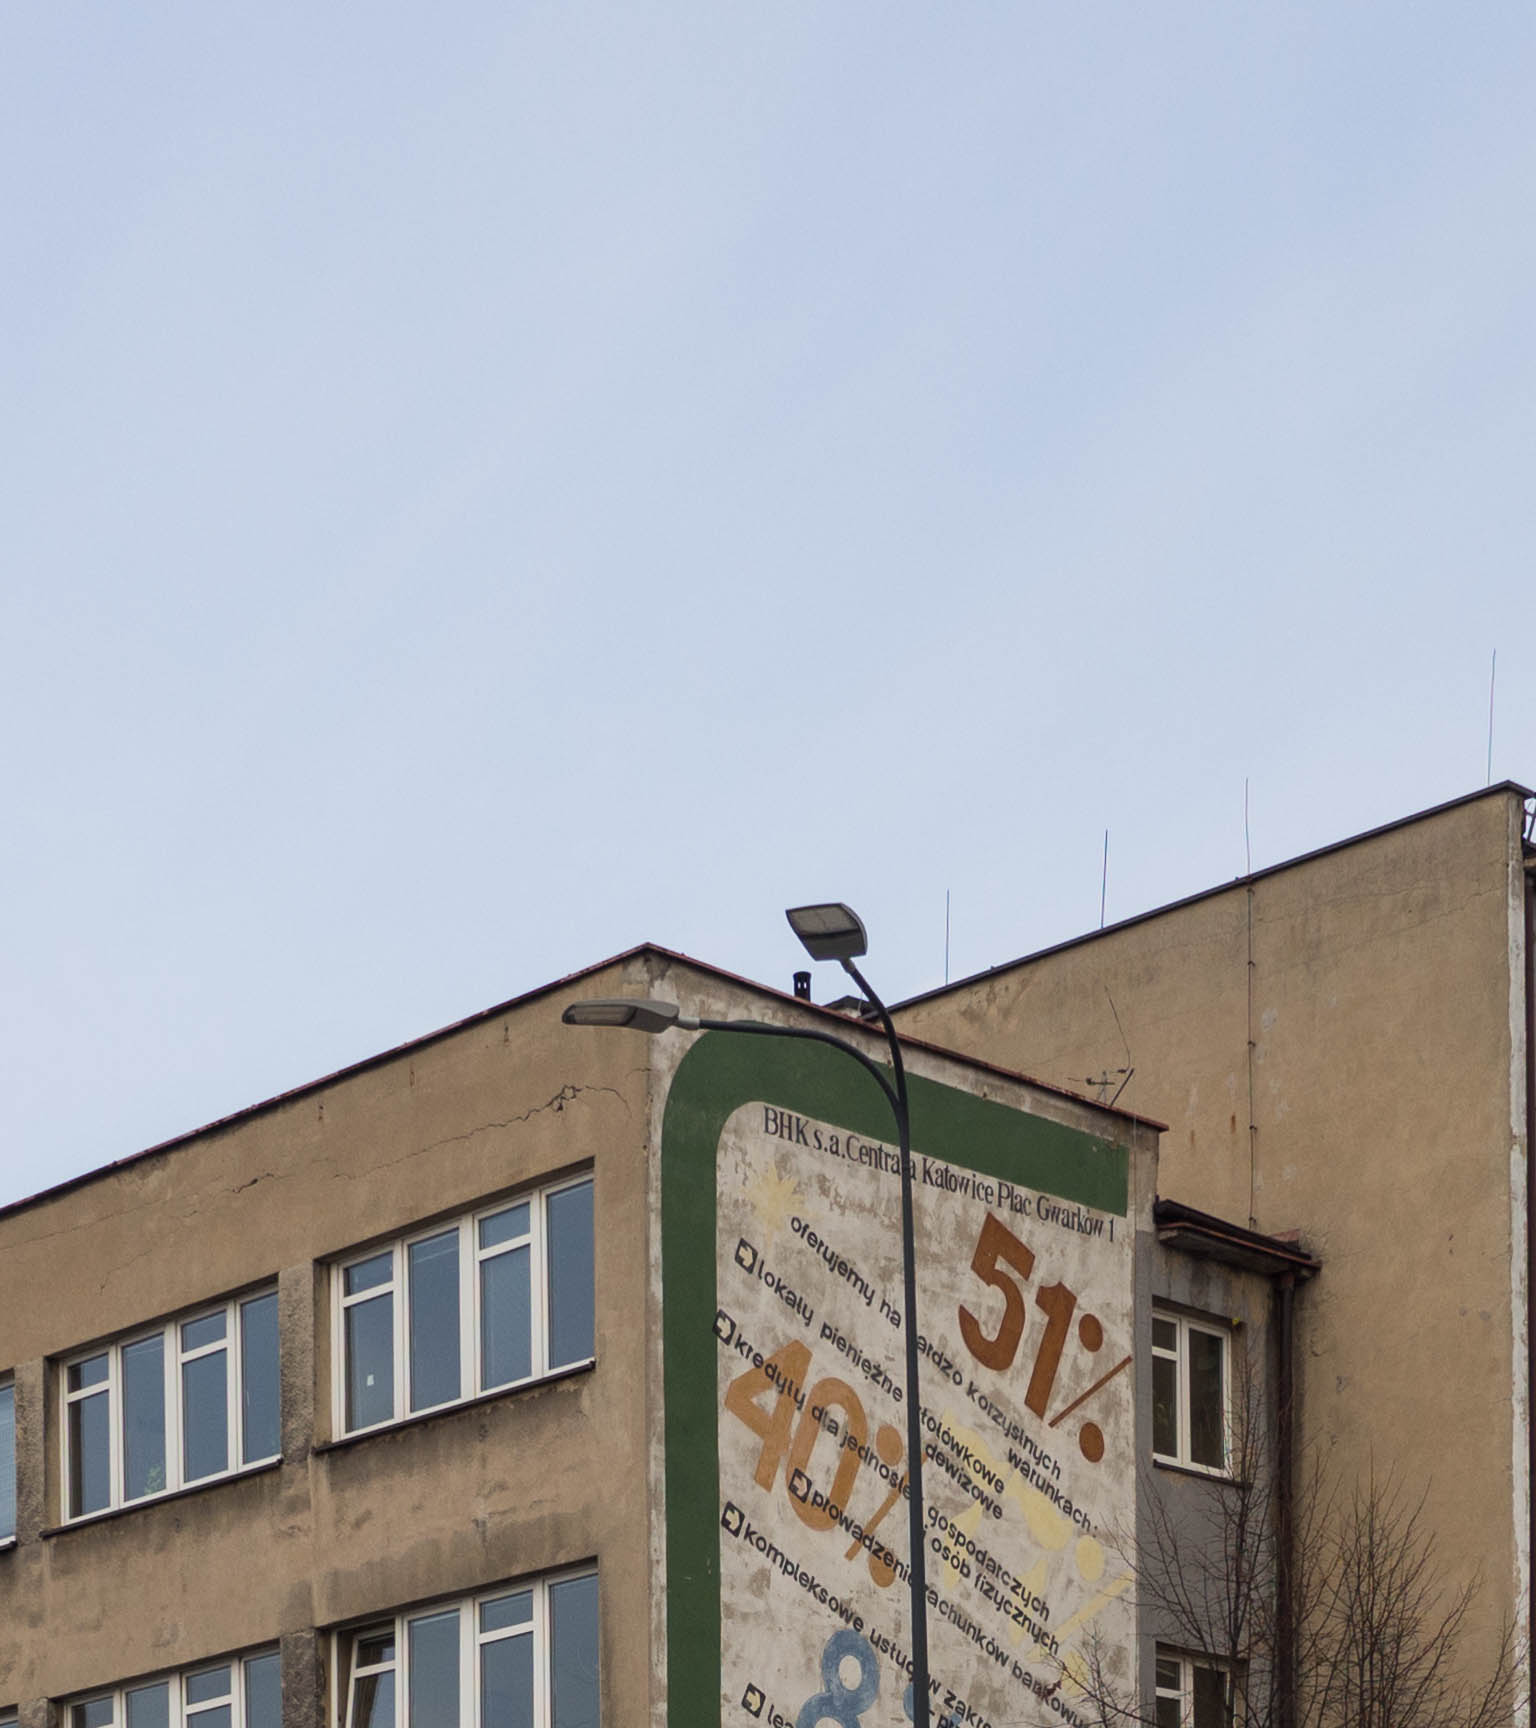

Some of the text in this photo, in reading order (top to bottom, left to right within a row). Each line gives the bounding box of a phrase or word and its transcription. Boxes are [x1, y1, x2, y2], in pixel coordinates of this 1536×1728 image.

[764, 1106, 809, 1147] BHK
[846, 1134, 917, 1181] Centraa
[922, 1157, 994, 1204] Katowice
[997, 1182, 1032, 1217] Plac
[1036, 1195, 1104, 1237] Gwarków
[1109, 1218, 1115, 1243] 1
[757, 1260, 814, 1327] lokaty
[819, 1321, 904, 1402] pieniężne
[790, 1216, 876, 1306] oferujemy
[879, 1298, 902, 1329] na
[917, 1335, 963, 1386] ardzo
[733, 1333, 1050, 1622] kredyty dla jednoste gospodarczych
[924, 1442, 1003, 1520] dewizowe
[743, 1522, 864, 1632] kompleksowe
[924, 1583, 1010, 1668] achunków
[931, 1536, 972, 1579] osób
[974, 1572, 1060, 1656] fizycznych
